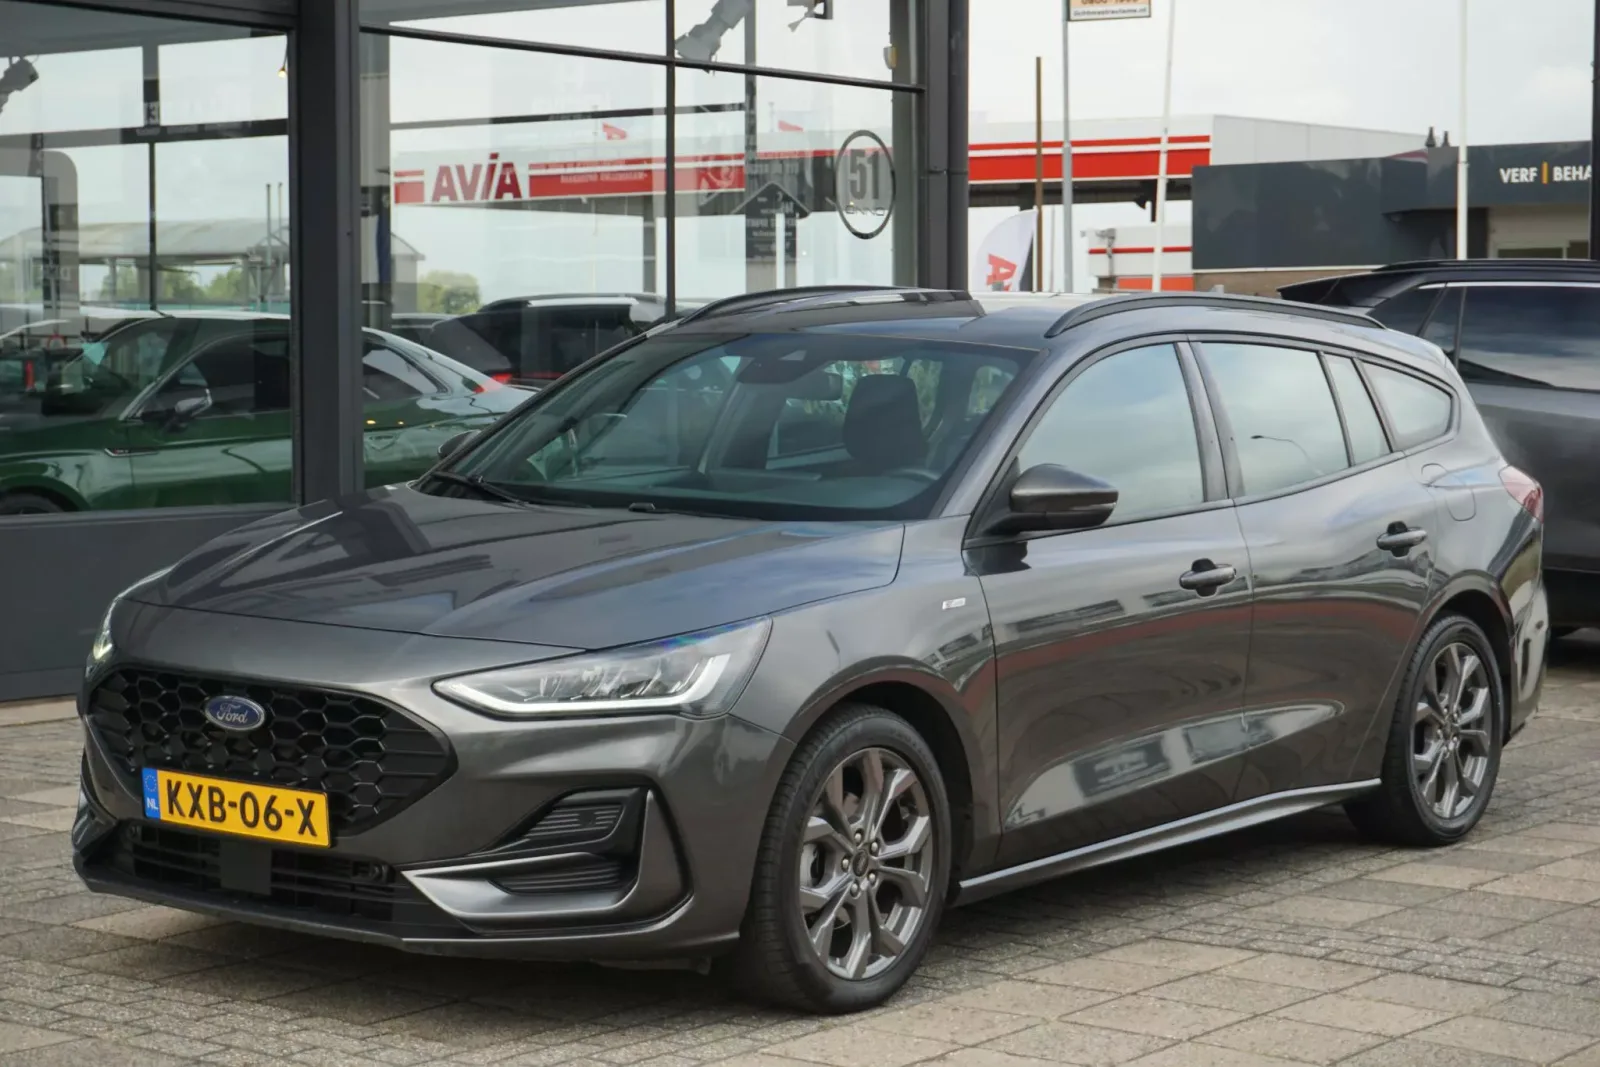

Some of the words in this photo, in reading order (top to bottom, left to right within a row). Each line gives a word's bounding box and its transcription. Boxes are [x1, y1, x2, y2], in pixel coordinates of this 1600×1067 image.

[848, 149, 880, 200] 51
[1499, 166, 1538, 184] VERF
[1553, 164, 1592, 182] BEHA
[216, 702, 249, 725] Ford
[146, 797, 159, 811] NL
[166, 778, 318, 838] KXB-06-X
